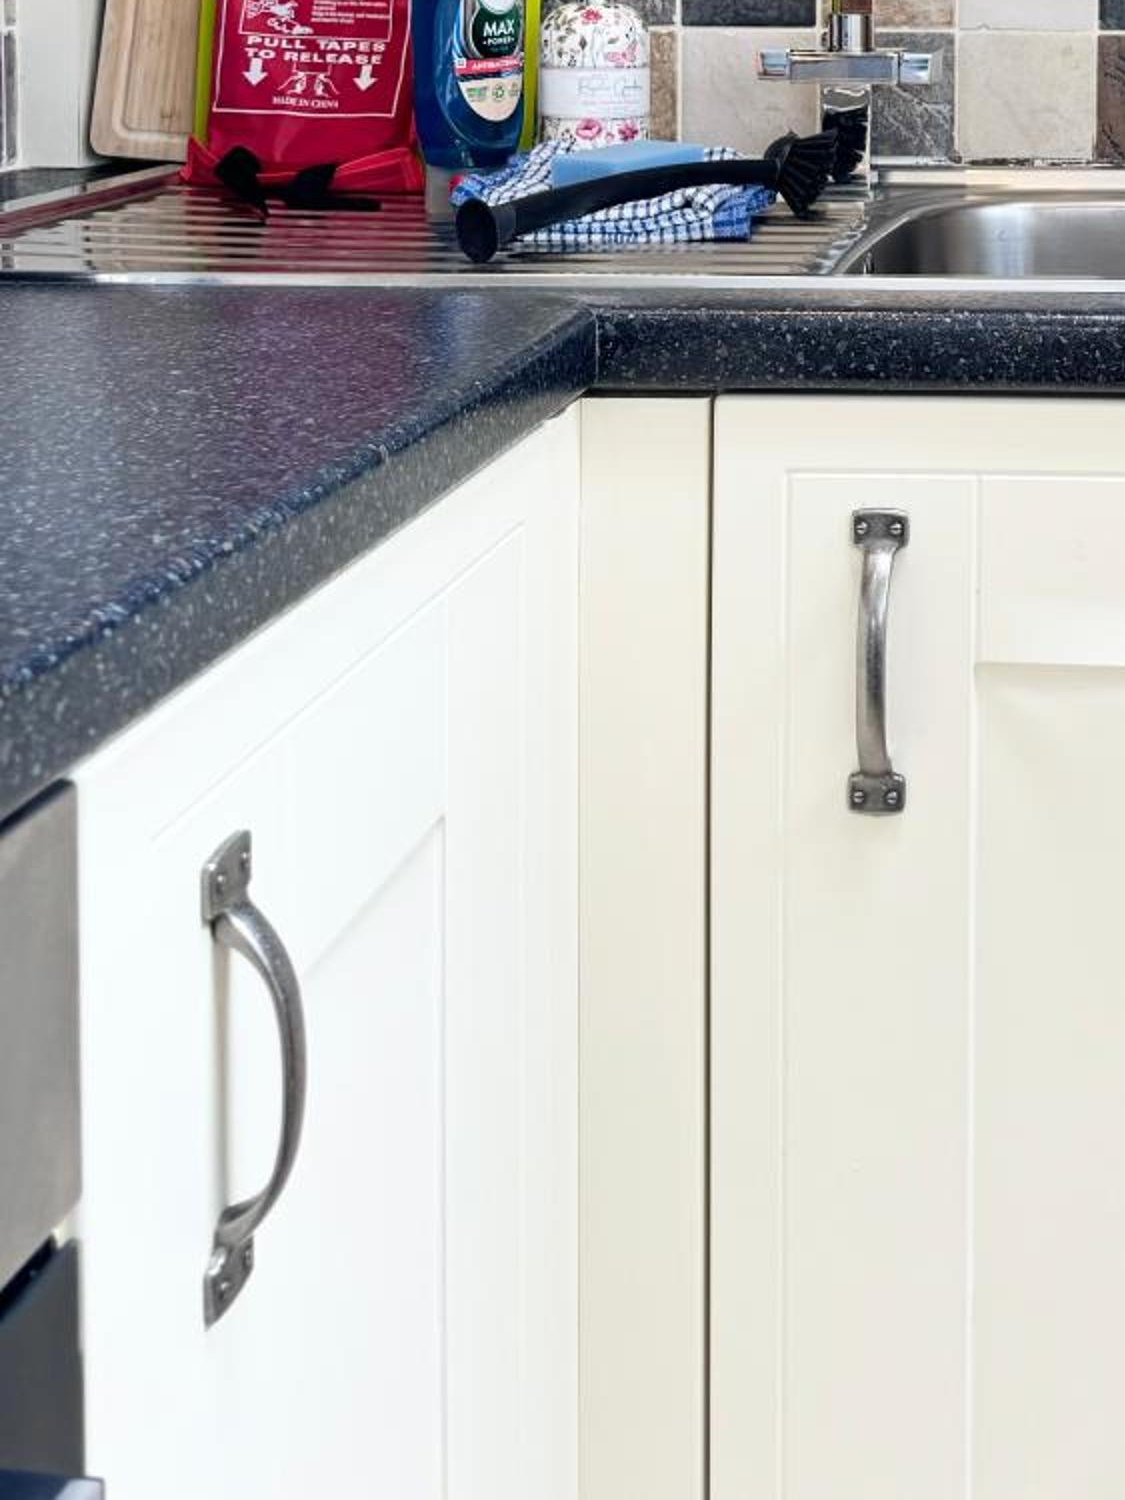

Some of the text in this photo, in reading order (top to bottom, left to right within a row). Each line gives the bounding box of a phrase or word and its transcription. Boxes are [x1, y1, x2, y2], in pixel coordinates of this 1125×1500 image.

[483, 19, 515, 38] MAX
[246, 36, 386, 52] PULL TAPES
[245, 47, 383, 65] TO RELEASE
